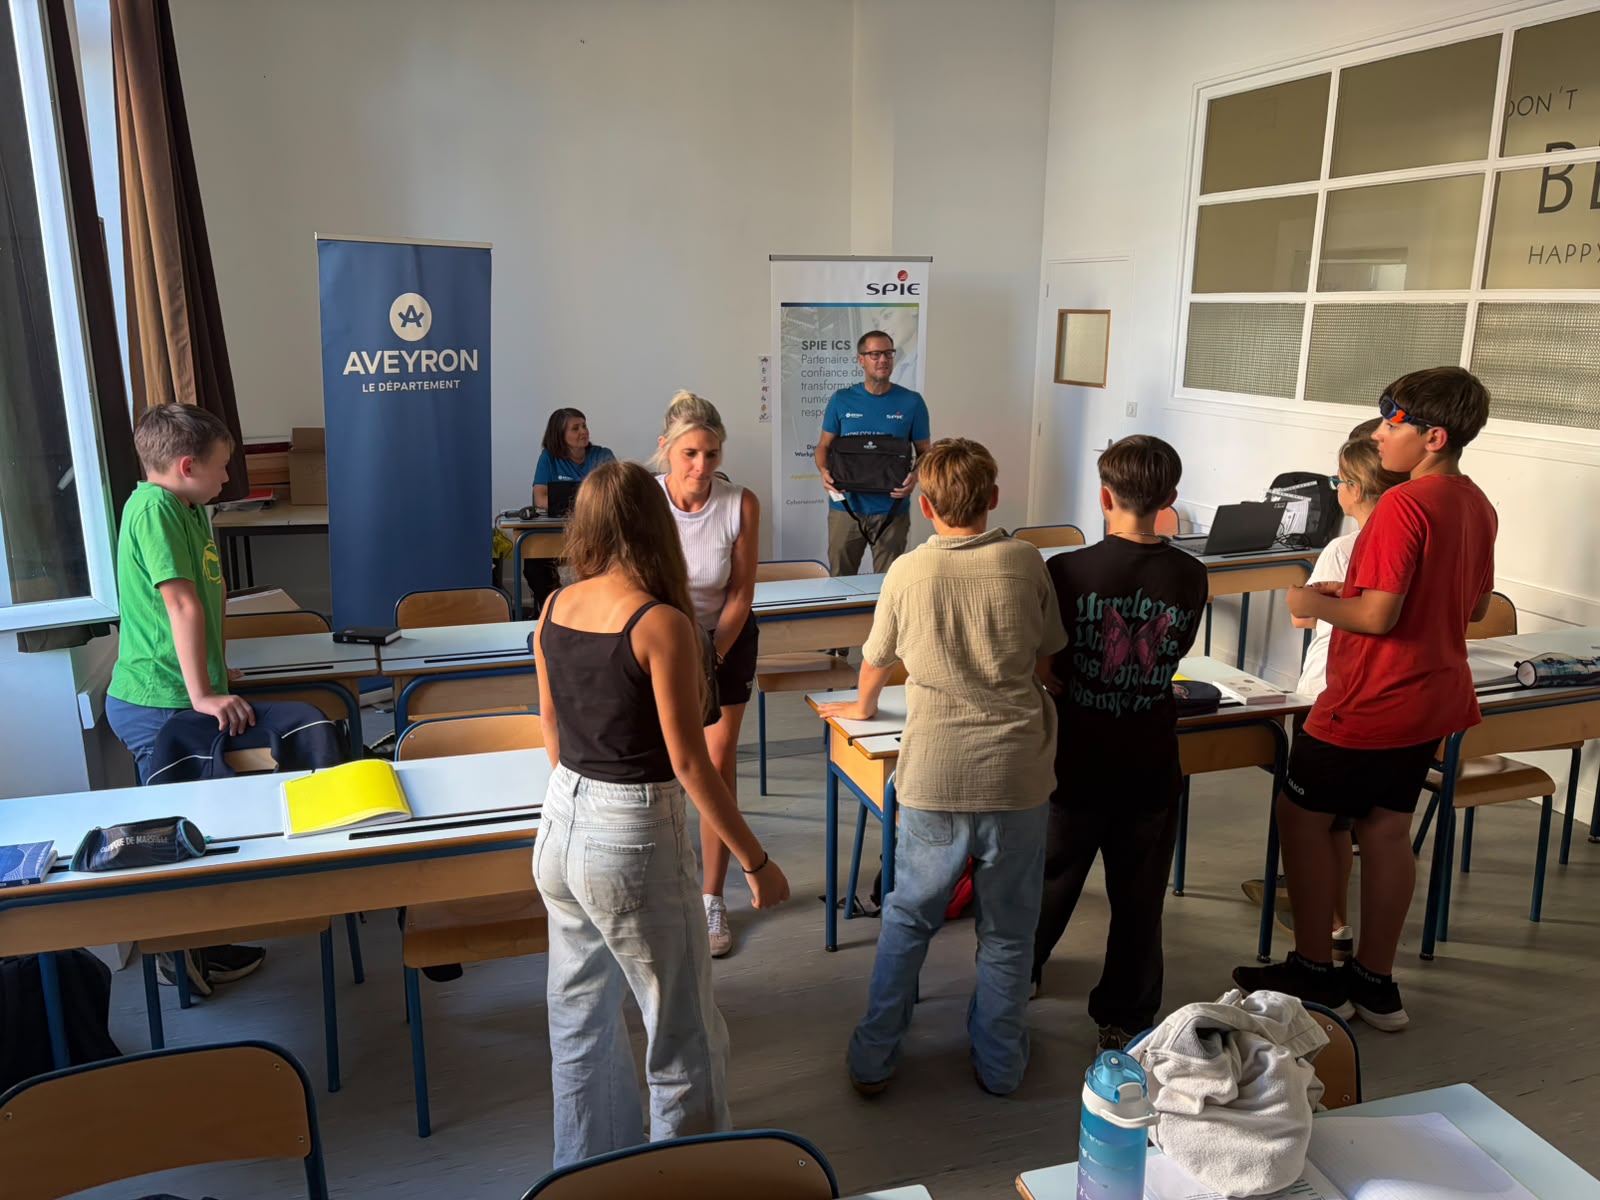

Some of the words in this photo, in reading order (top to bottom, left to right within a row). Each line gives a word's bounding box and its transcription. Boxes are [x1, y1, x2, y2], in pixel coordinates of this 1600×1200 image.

[866, 277, 920, 296] SPIE
[801, 340, 828, 350] SPIE
[831, 340, 851, 350] ICS
[342, 349, 478, 375] AVEYRON
[801, 354, 849, 364] Partenaire
[851, 355, 859, 364] d
[801, 366, 849, 377] confiance
[851, 366, 864, 378] de
[362, 383, 375, 393] LE
[378, 380, 461, 392] DÉPARTEMENT
[125, 836, 135, 845] DE
